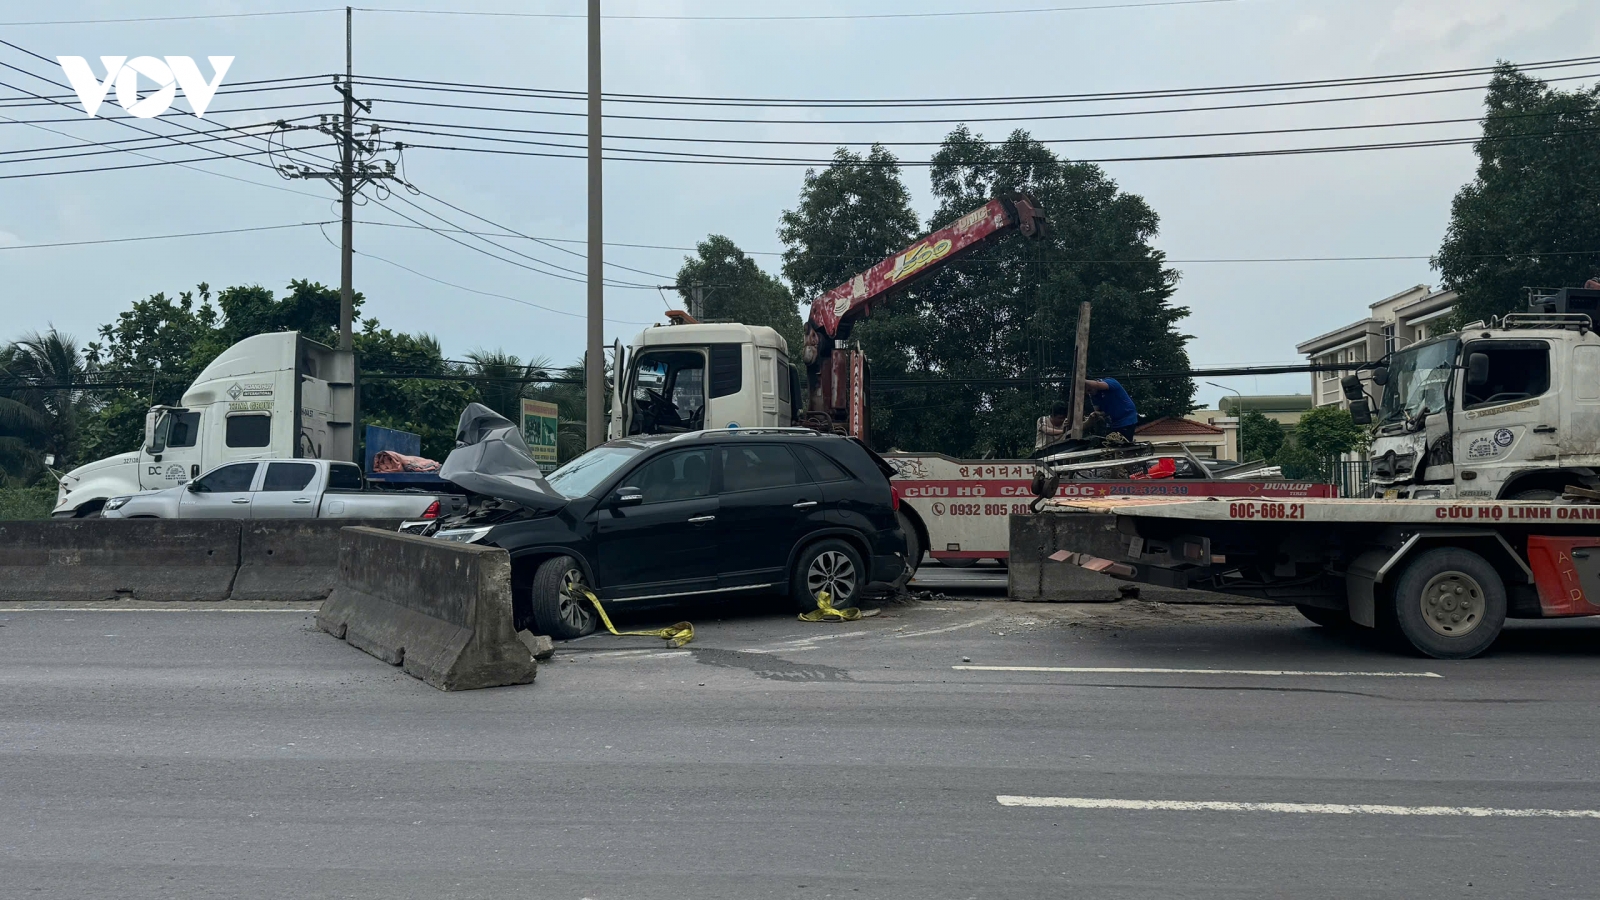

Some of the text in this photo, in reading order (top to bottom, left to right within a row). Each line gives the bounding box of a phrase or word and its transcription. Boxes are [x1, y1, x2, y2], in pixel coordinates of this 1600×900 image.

[148, 466, 162, 475] DC
[905, 484, 949, 497] CỨU
[1109, 485, 1189, 495] 29C-329.39
[1263, 482, 1313, 491] DUNLOP
[950, 503, 981, 516] 0932
[984, 503, 1008, 516] 805
[1229, 502, 1305, 519] 60C-668.21
[1435, 505, 1473, 519] CỨU
[1478, 505, 1503, 521] HỘ
[1507, 507, 1552, 519] LINH
